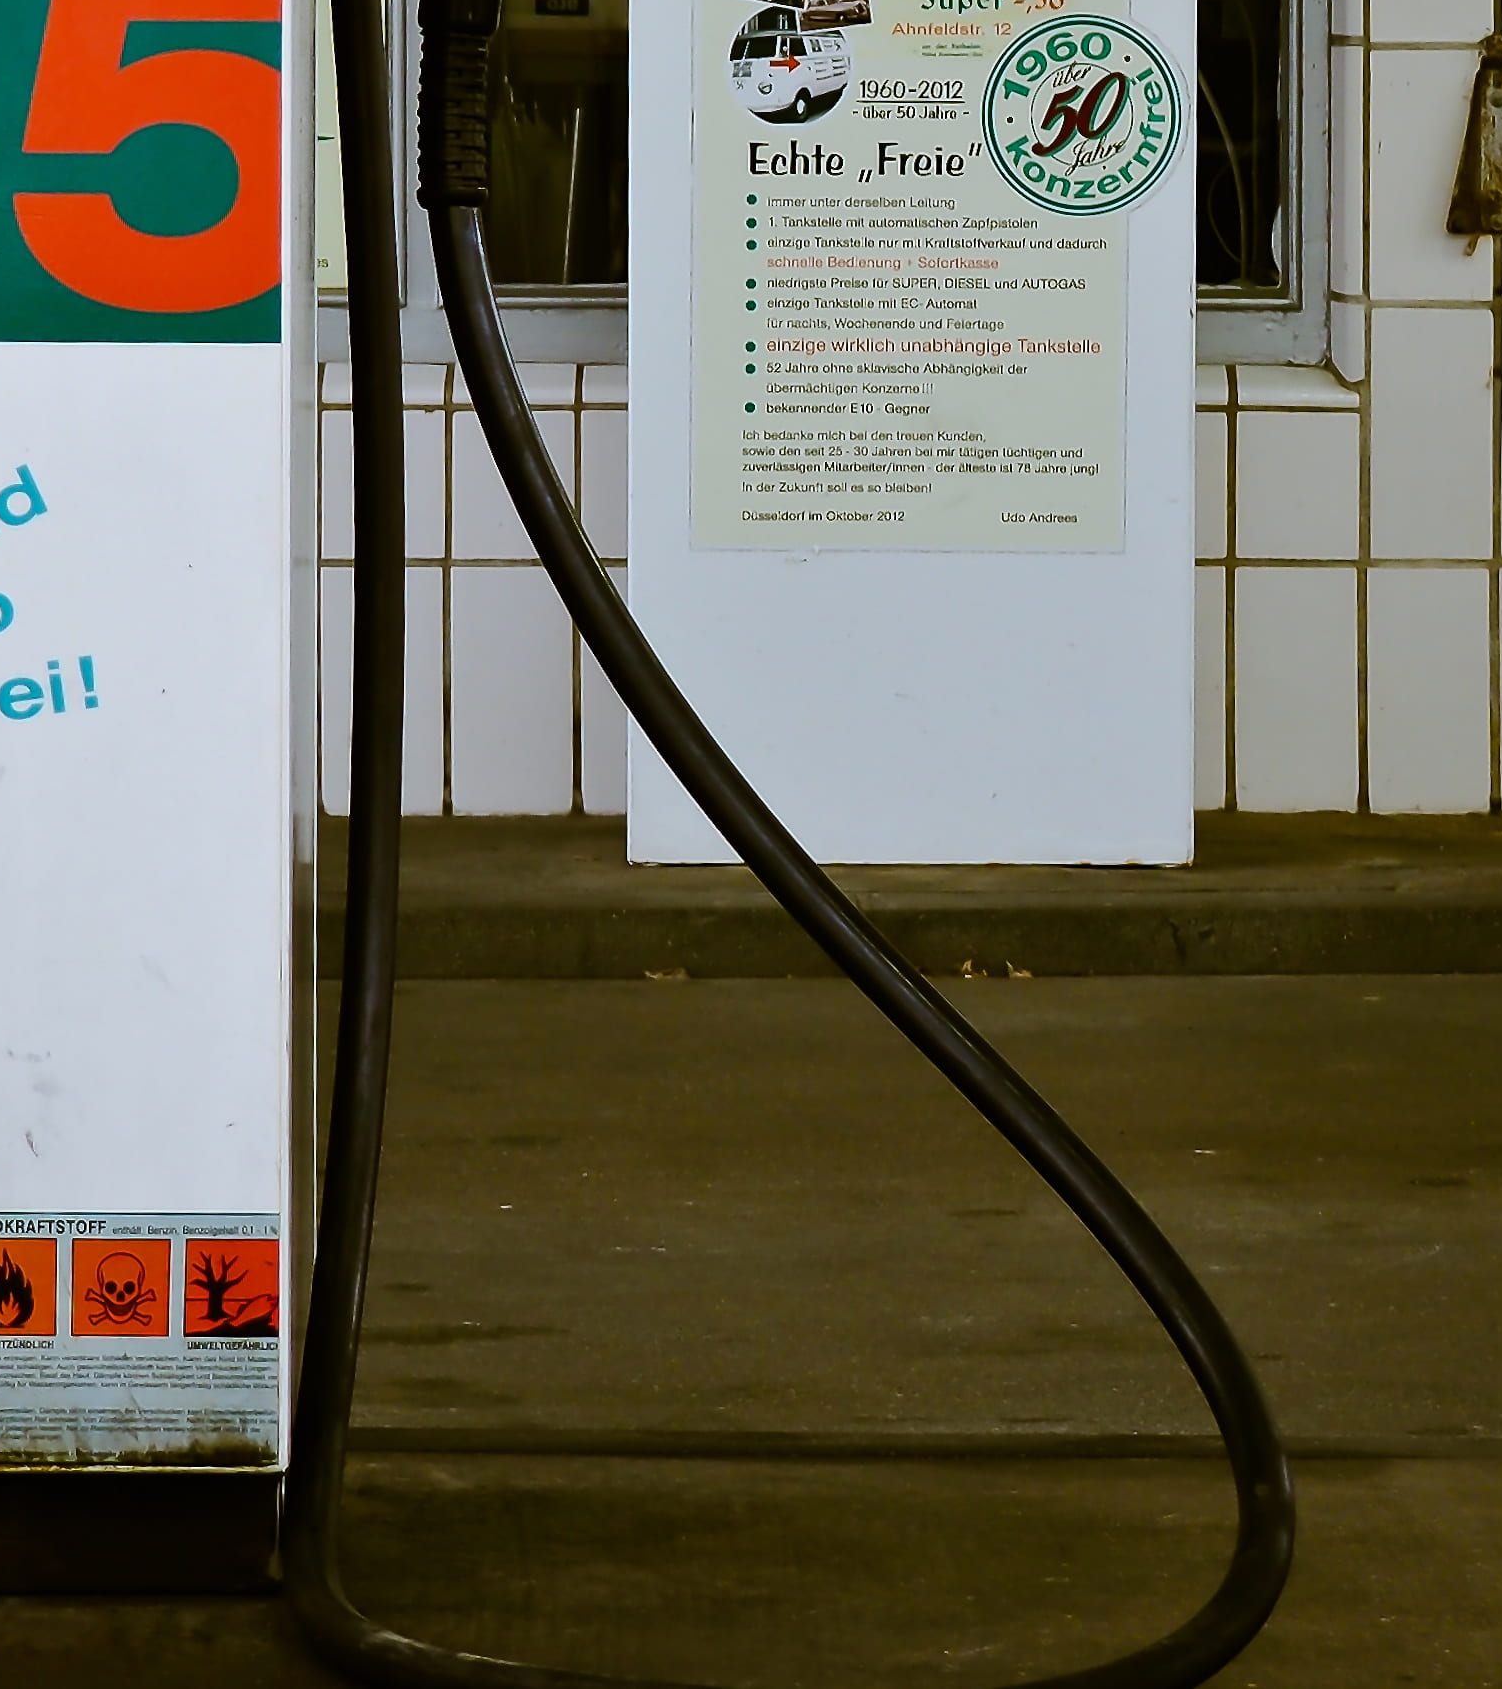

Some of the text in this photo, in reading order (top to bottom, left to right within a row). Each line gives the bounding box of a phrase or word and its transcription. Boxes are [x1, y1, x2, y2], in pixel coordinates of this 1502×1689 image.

[892, 22, 1013, 37] Ahnfeldstr. 12
[1002, 31, 1112, 100] 1960
[1052, 60, 1092, 88] über
[860, 80, 964, 100] 1960-2012
[863, 105, 958, 121] über 50 Jahre
[1031, 71, 1130, 157] 50
[750, 139, 845, 178] Echte
